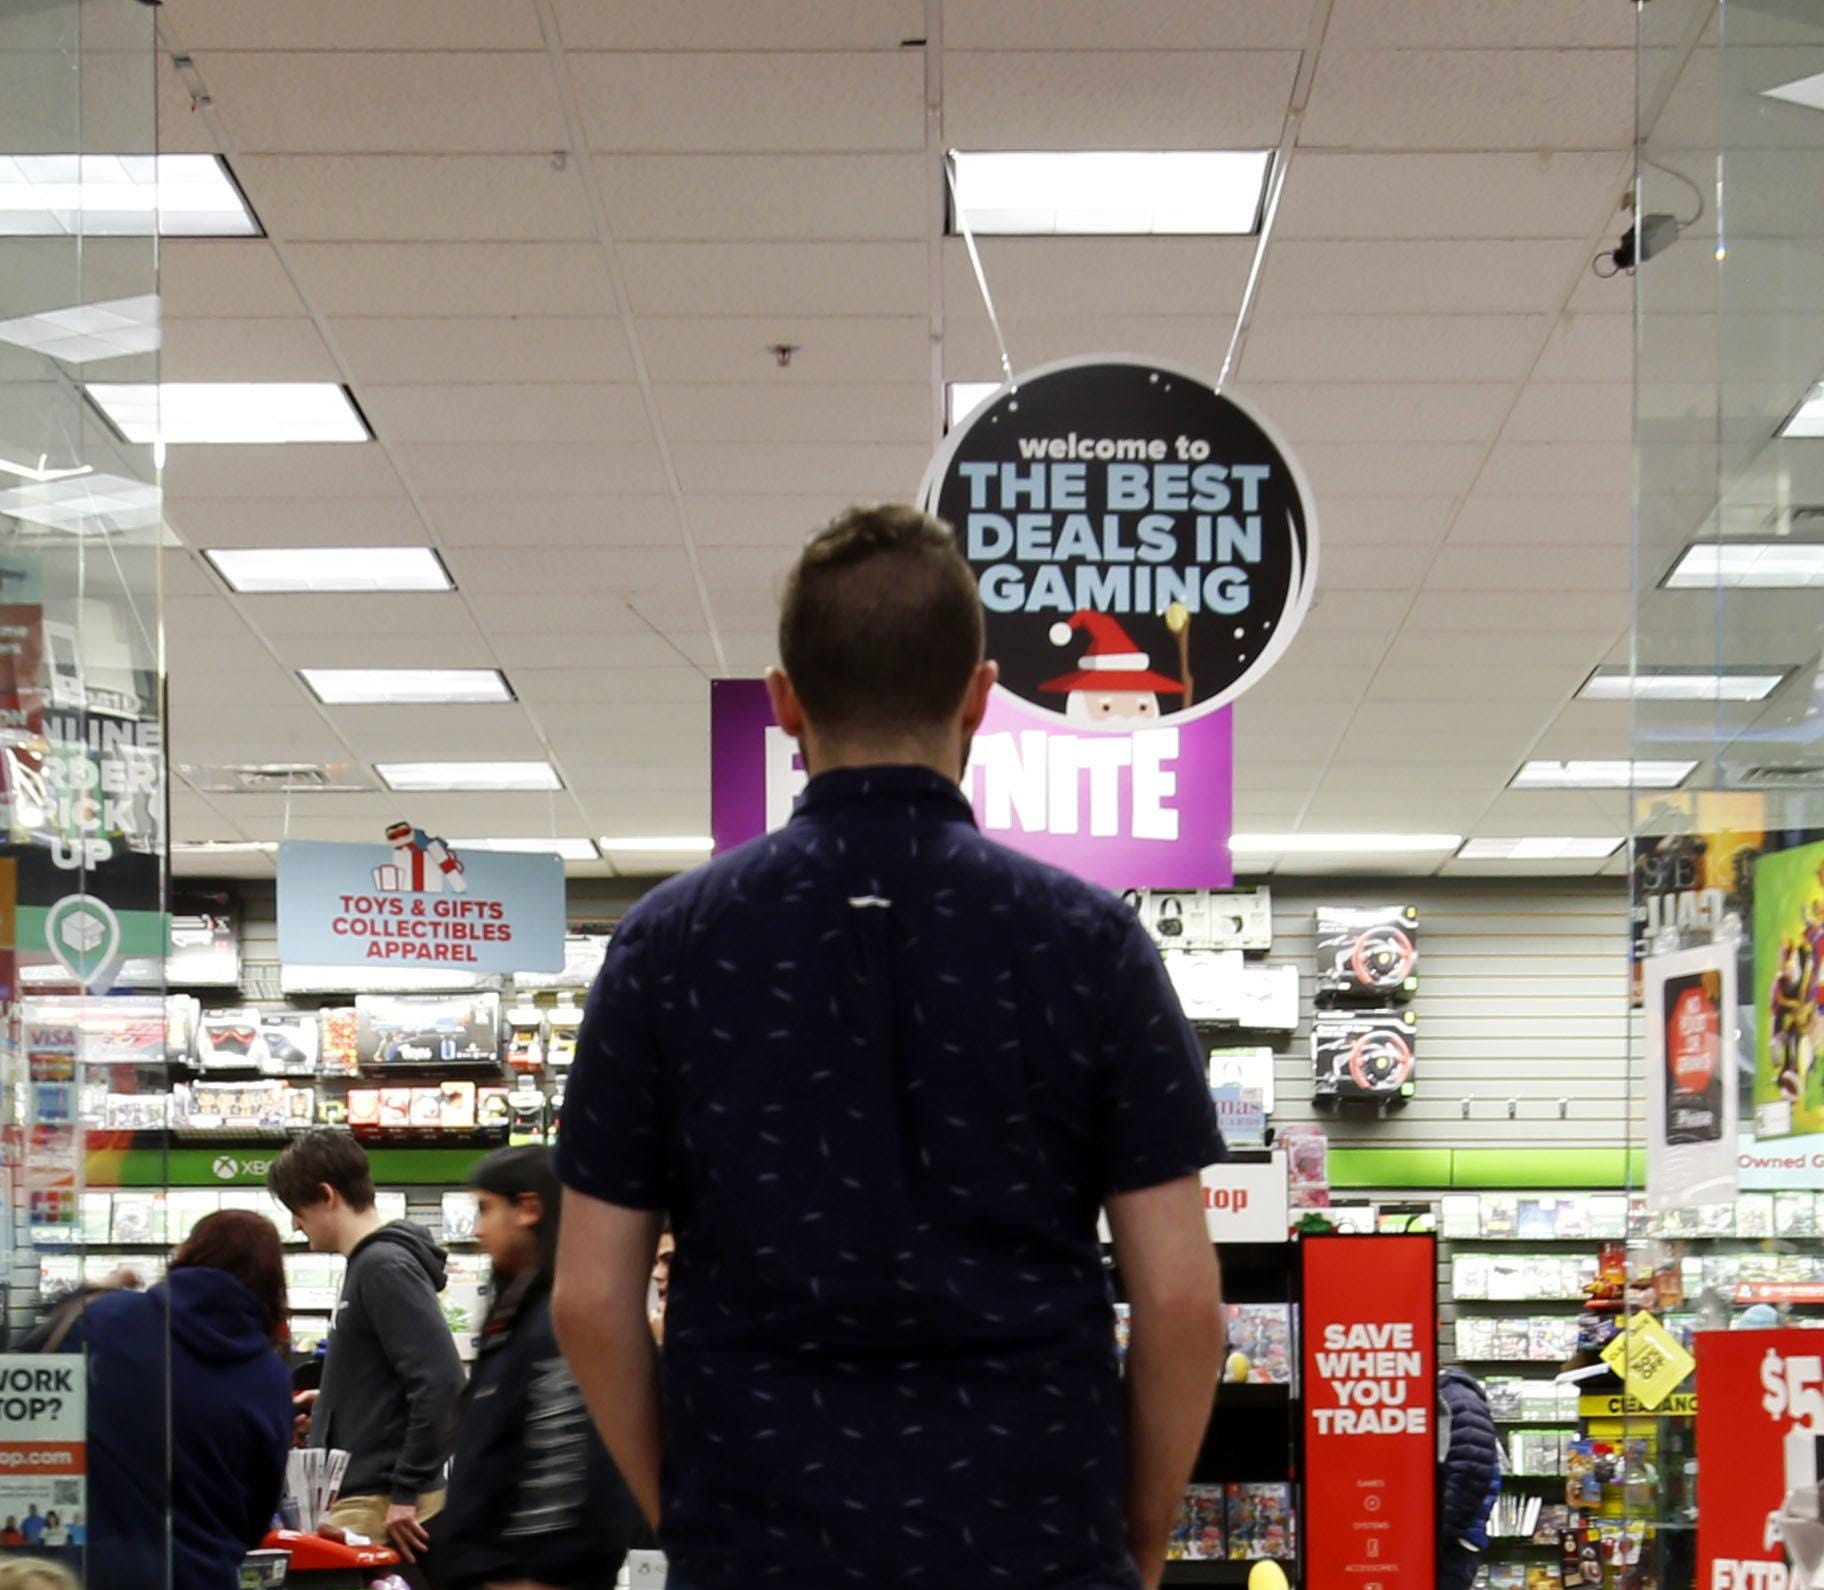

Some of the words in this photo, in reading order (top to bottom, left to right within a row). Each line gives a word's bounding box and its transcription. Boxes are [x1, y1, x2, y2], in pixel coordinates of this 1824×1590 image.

[1018, 433, 1166, 461] welcome
[1175, 434, 1210, 461] to
[958, 462, 1088, 511] THE
[1106, 463, 1271, 515] BEST
[966, 513, 1177, 564] DEALS
[1194, 514, 1263, 564] IN
[977, 564, 1251, 616] GAMING
[50, 837, 114, 871] UP
[340, 895, 404, 917] TOYS
[410, 897, 428, 917] &
[433, 899, 504, 920] GIFTS
[332, 917, 512, 943] COLLECTIBLES
[366, 941, 478, 963] APPAREL
[31, 1029, 76, 1045] VISA
[1738, 1154, 1807, 1169] Owned
[1324, 1323, 1414, 1350] SAVE
[1314, 1351, 1422, 1378] WHEN
[1331, 1380, 1408, 1406] YOU
[1312, 1408, 1426, 1435] TRADE
